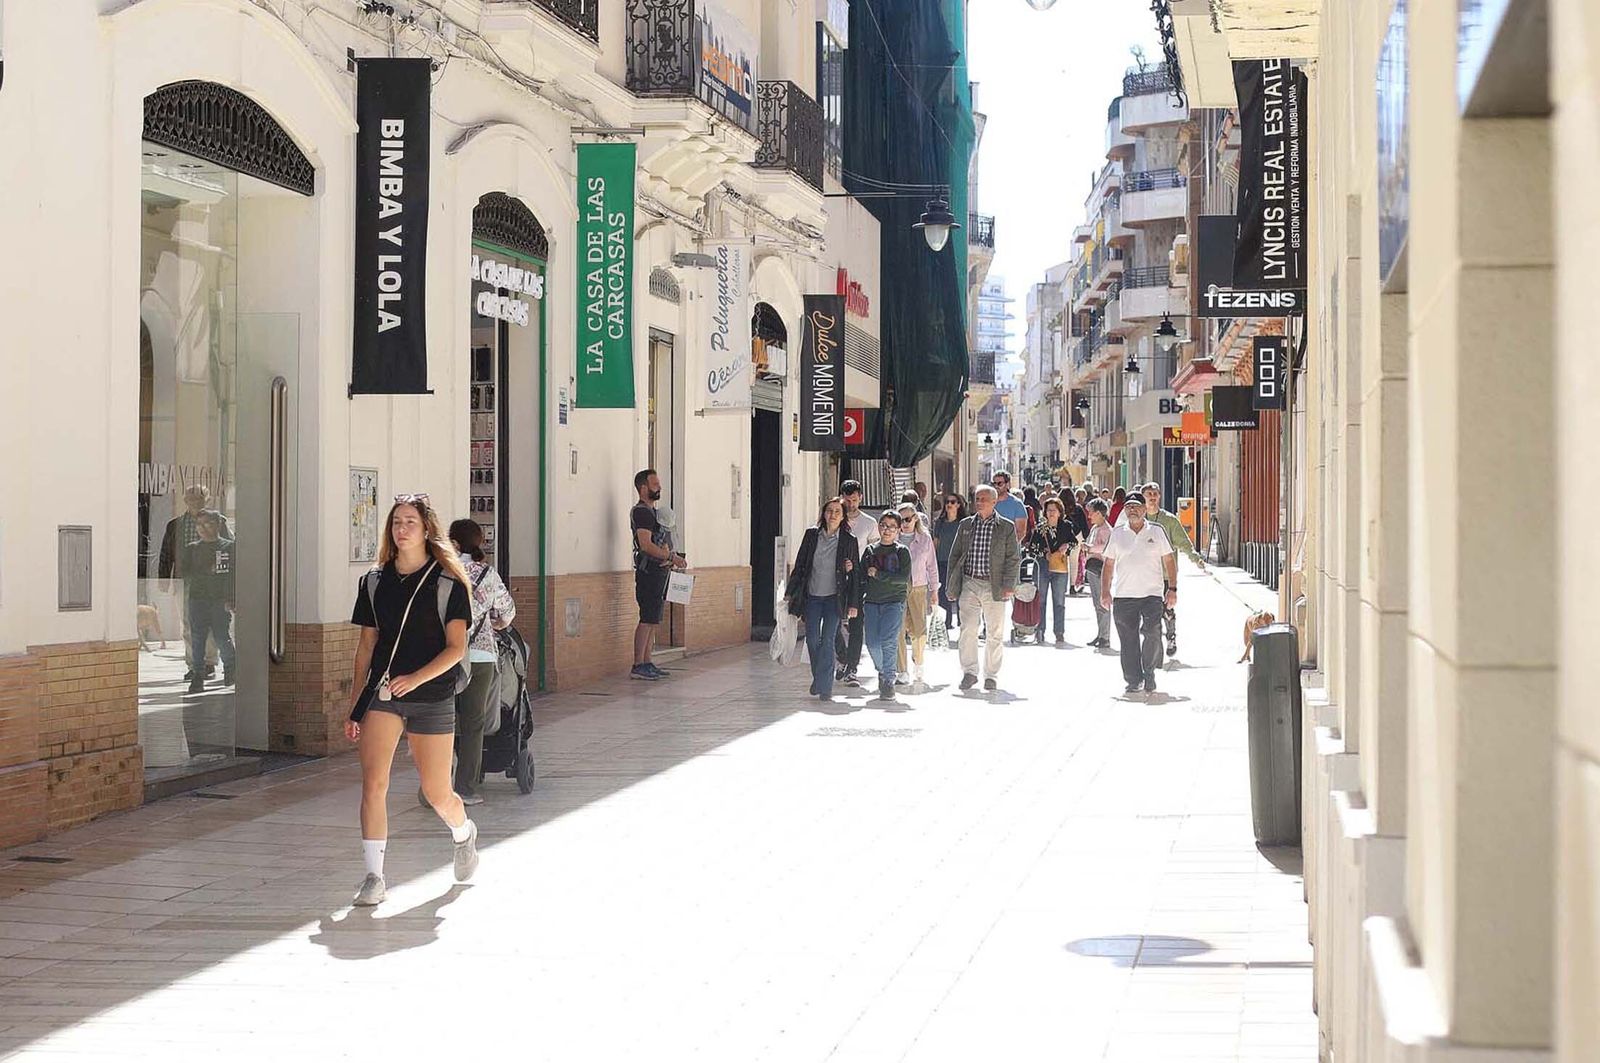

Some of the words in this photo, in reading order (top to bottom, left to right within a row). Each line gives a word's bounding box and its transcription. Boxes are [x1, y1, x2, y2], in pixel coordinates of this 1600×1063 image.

[1262, 58, 1284, 136] ESTATE
[1288, 84, 1299, 137] INMOBILIARIA
[378, 118, 405, 219] BIMBA
[1263, 140, 1285, 200] REAL
[1290, 138, 1300, 178] REFORMA
[587, 177, 605, 223] LAS
[1290, 187, 1300, 215] VENTA
[378, 224, 403, 247] Y
[587, 231, 604, 264] DE
[1263, 206, 1286, 280] LYNCIS
[1291, 215, 1300, 249] GESTION
[377, 254, 402, 333] LOLA
[587, 268, 604, 332] CASA
[608, 212, 625, 340] CARCASAS
[710, 244, 734, 352] Peluquería
[587, 340, 604, 375] LA
[811, 310, 838, 364] Dulce
[812, 364, 835, 436] MOMENTO
[139, 462, 176, 495] IMBA
